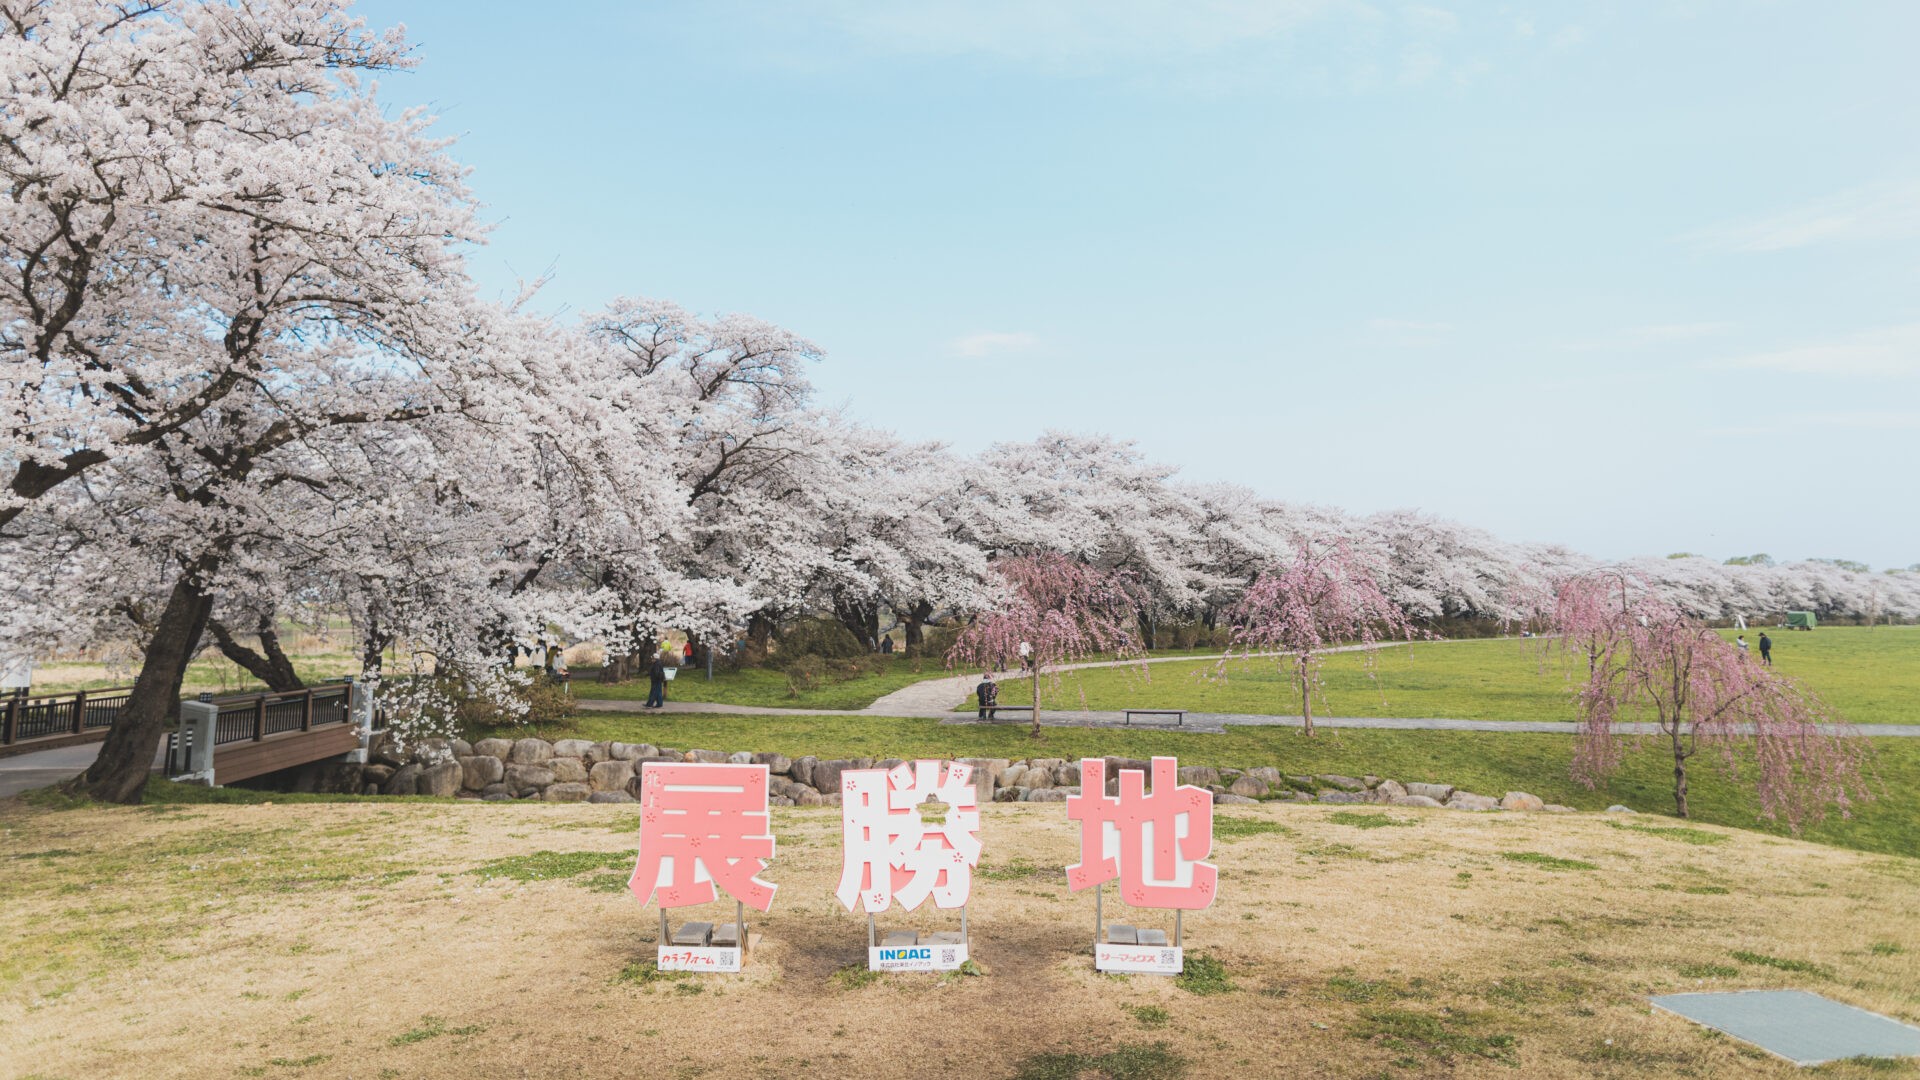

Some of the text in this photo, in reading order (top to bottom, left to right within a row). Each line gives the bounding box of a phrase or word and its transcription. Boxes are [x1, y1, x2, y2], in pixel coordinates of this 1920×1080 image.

[662, 952, 714, 966] カラーフォーム
[880, 949, 931, 960] INOAC
